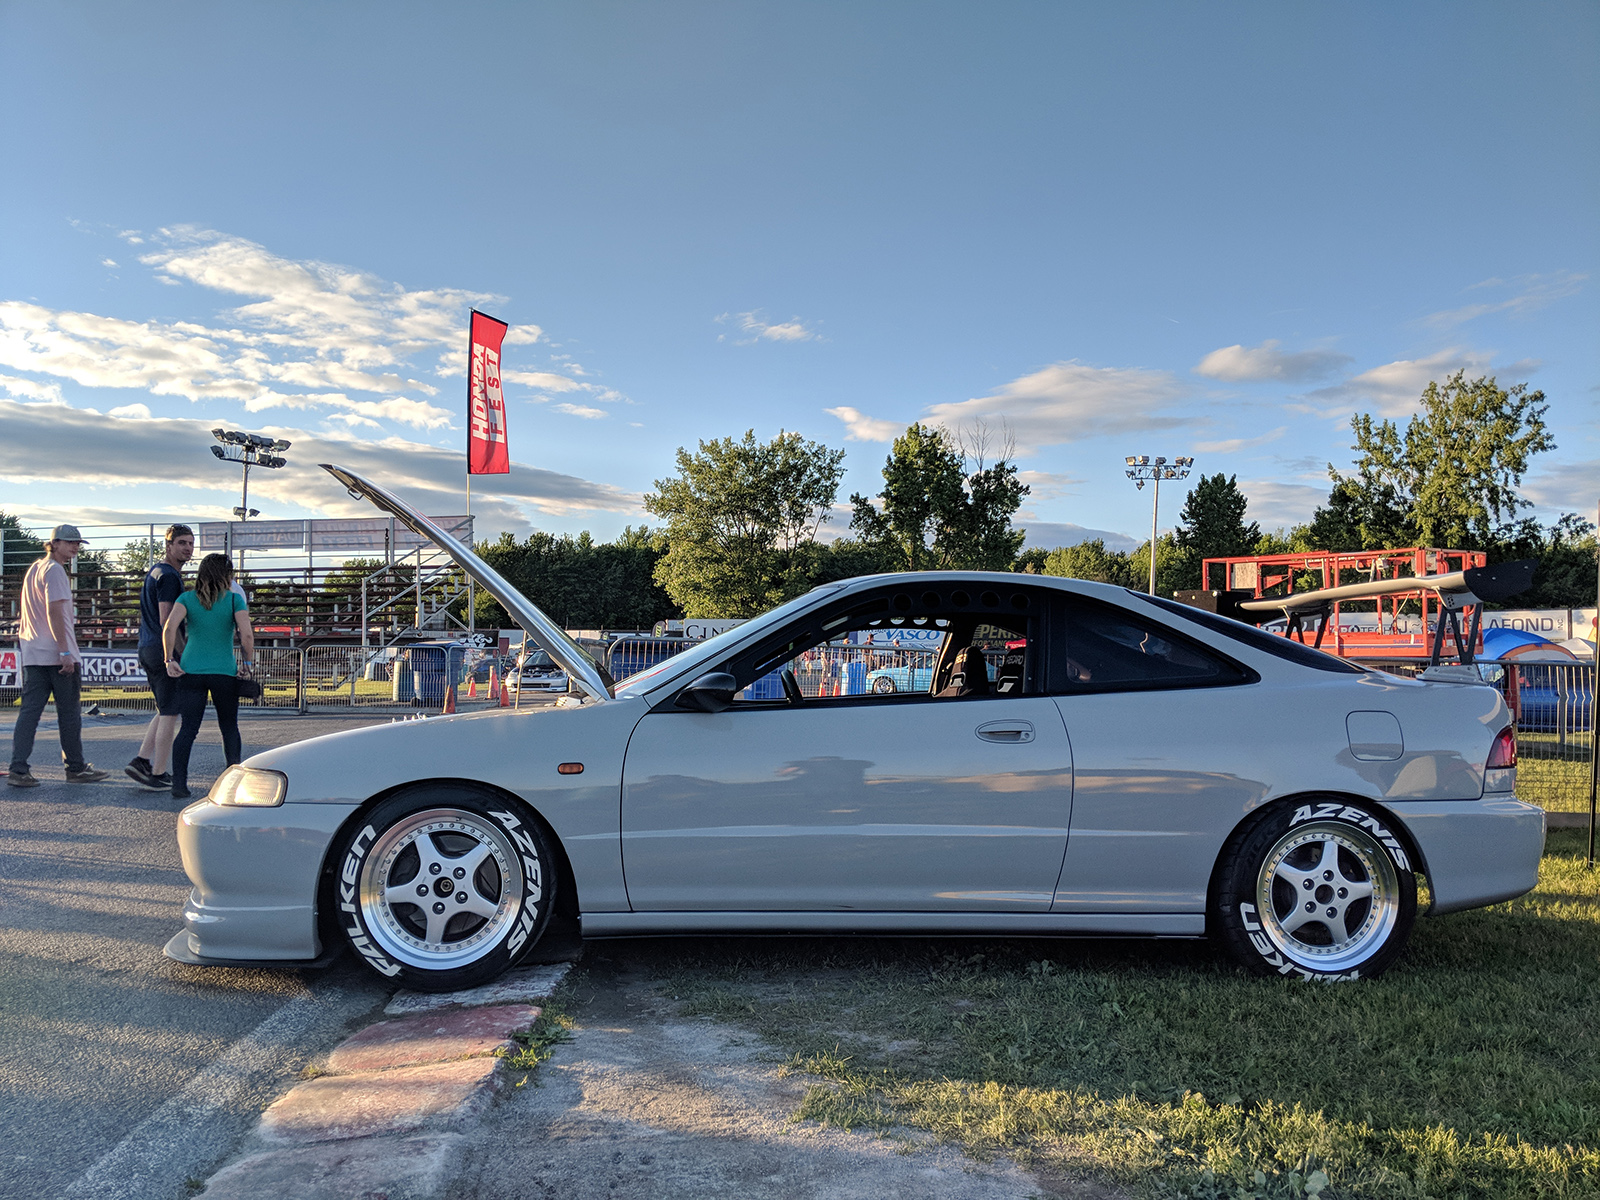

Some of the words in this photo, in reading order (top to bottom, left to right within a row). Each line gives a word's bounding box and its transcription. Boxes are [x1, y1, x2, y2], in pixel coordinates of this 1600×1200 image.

[472, 342, 490, 441] HONDA
[486, 353, 504, 436] FEST
[886, 628, 940, 640] VASCO
[1289, 803, 1411, 873] AZENIS
[340, 824, 402, 977] FALKEN
[487, 810, 542, 960] AZENIS
